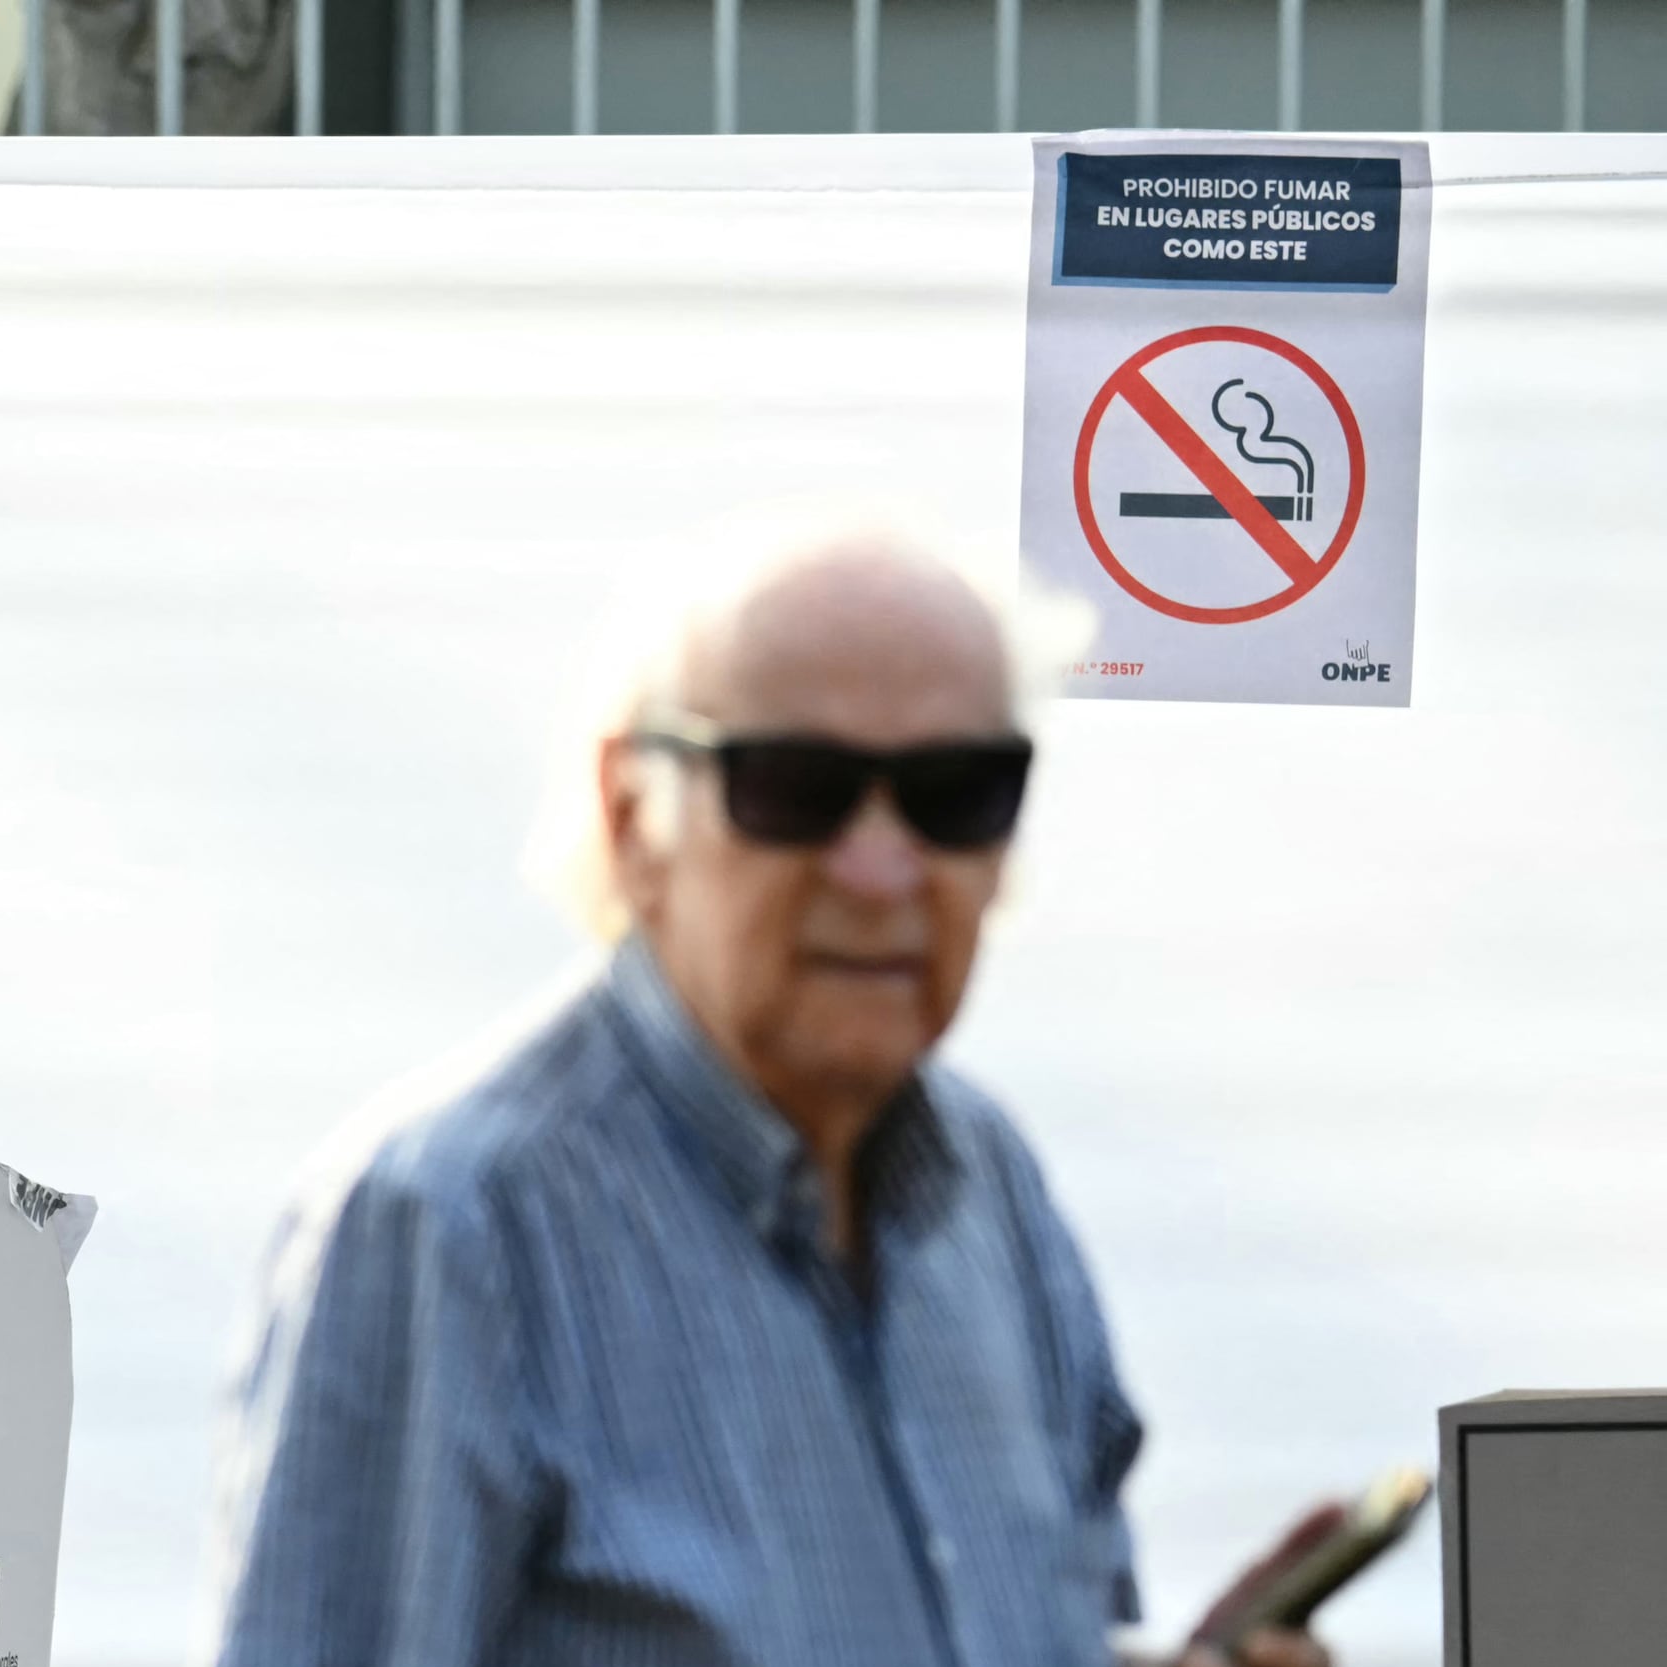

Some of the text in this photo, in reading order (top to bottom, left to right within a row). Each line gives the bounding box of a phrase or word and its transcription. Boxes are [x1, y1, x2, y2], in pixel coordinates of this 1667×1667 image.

[1124, 178, 1350, 200] PROHIBIDO FUMAR
[1098, 204, 1375, 231] EN LUGARES PÚBLICOS
[1164, 239, 1307, 260] COMO ESTE
[1100, 662, 1144, 676] 29517
[1322, 662, 1390, 682] ONPE
